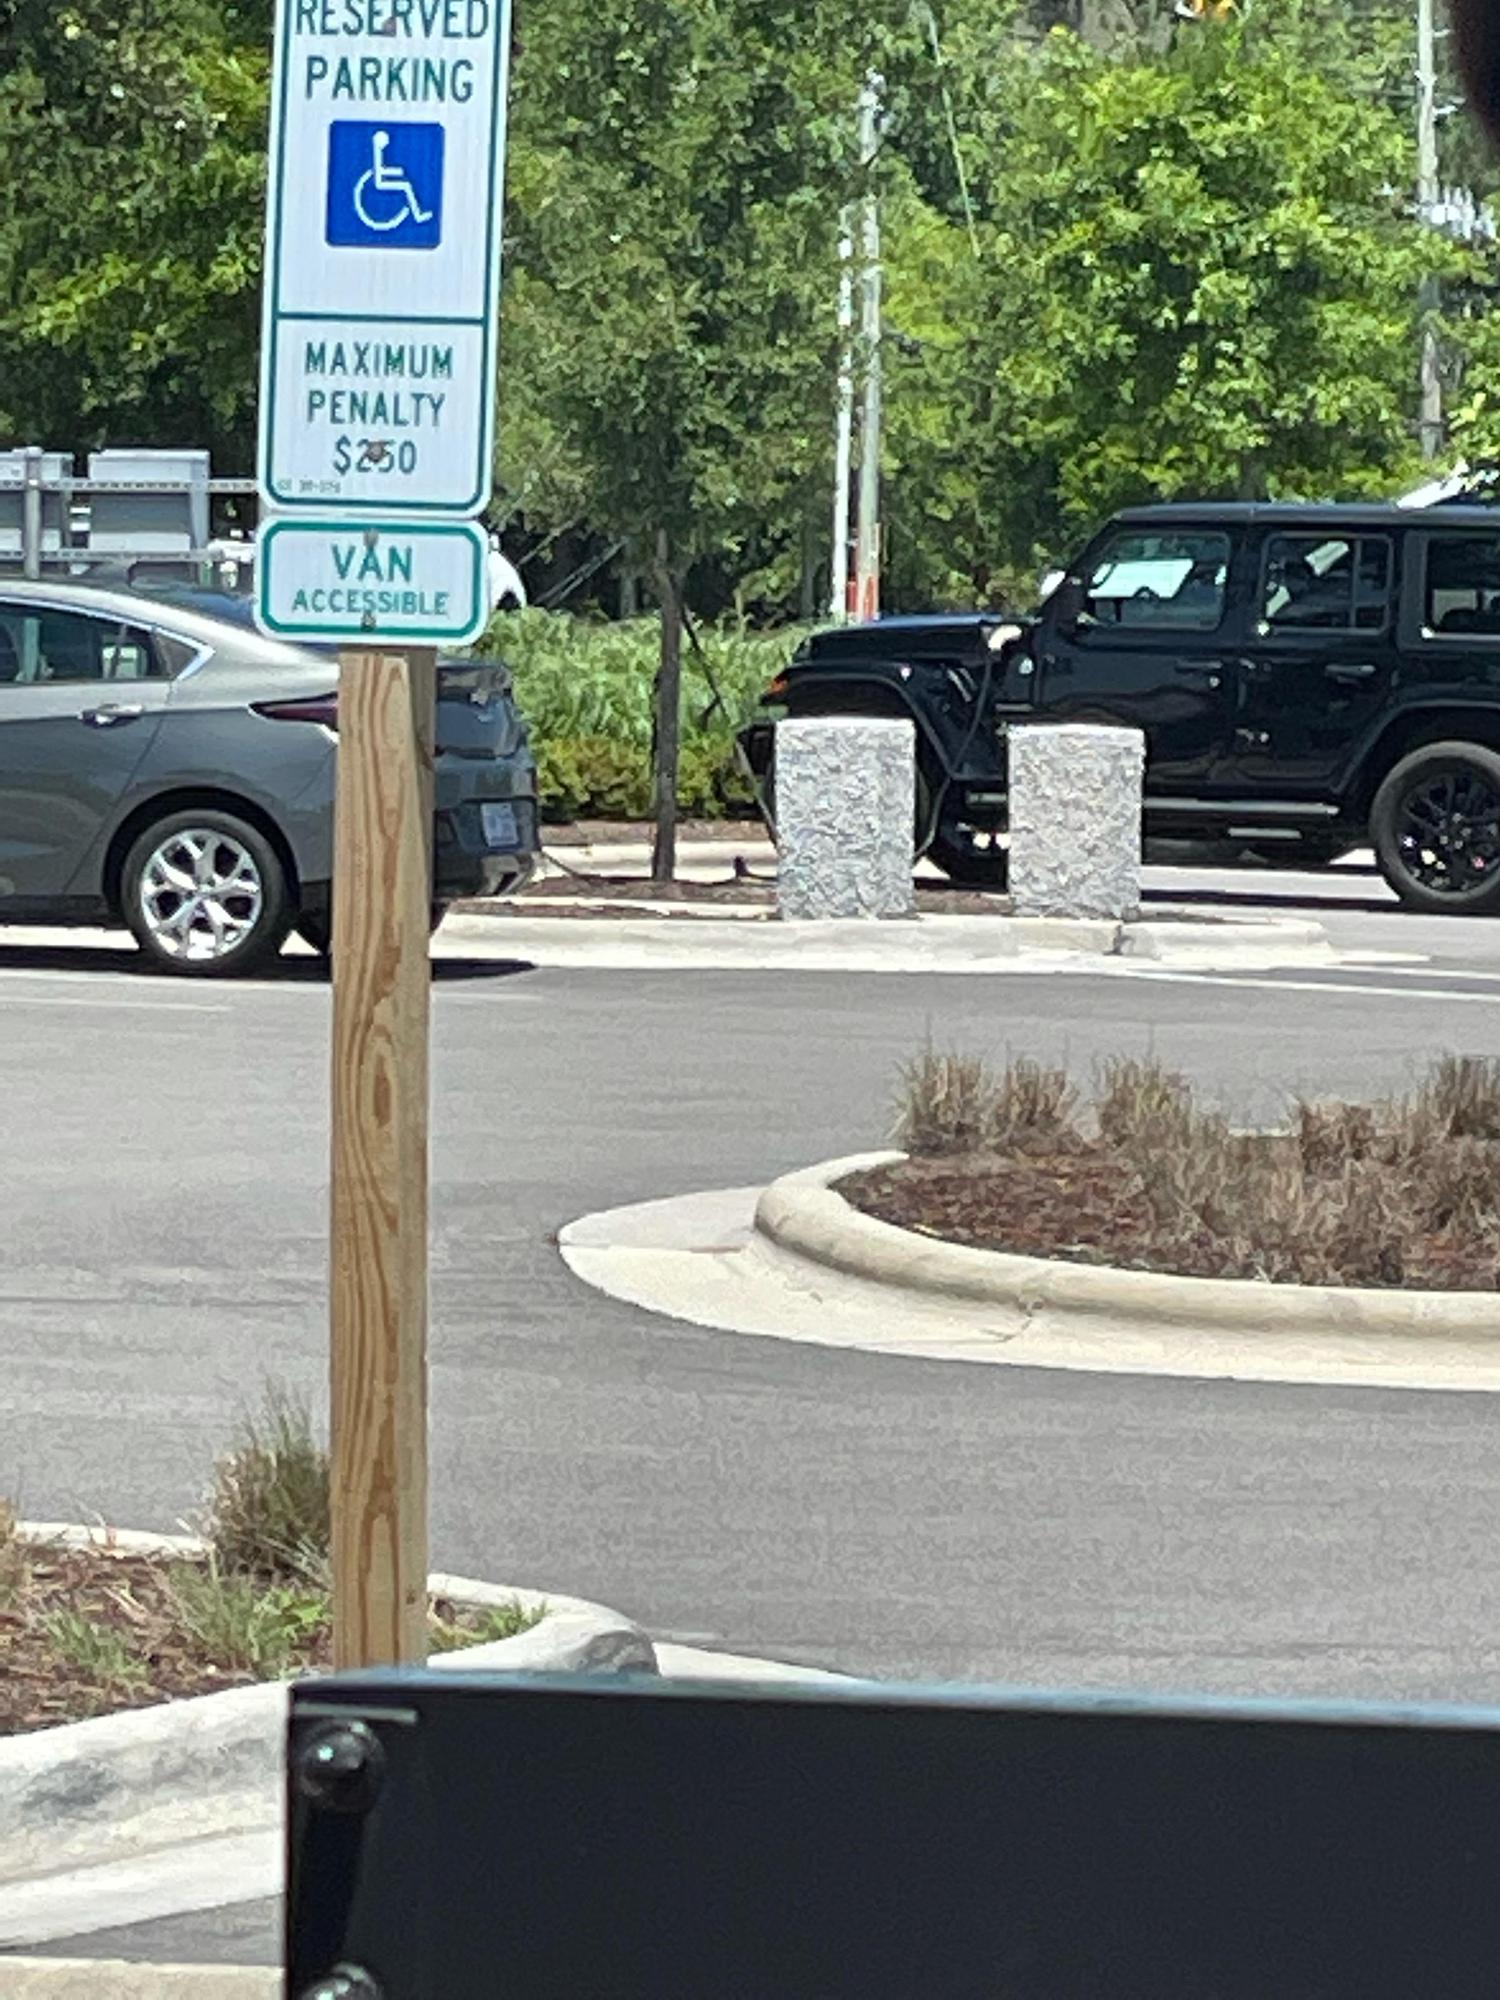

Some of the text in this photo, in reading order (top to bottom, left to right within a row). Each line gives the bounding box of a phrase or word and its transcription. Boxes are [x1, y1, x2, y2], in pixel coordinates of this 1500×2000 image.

[294, 0, 489, 39] RESERVED
[305, 55, 475, 103] PARKING
[303, 341, 454, 379] MAXIMUM
[306, 390, 447, 428] PENALTY
[332, 434, 417, 476] $250
[331, 545, 413, 584] VAN
[291, 589, 449, 616] ACCESSIBLE
